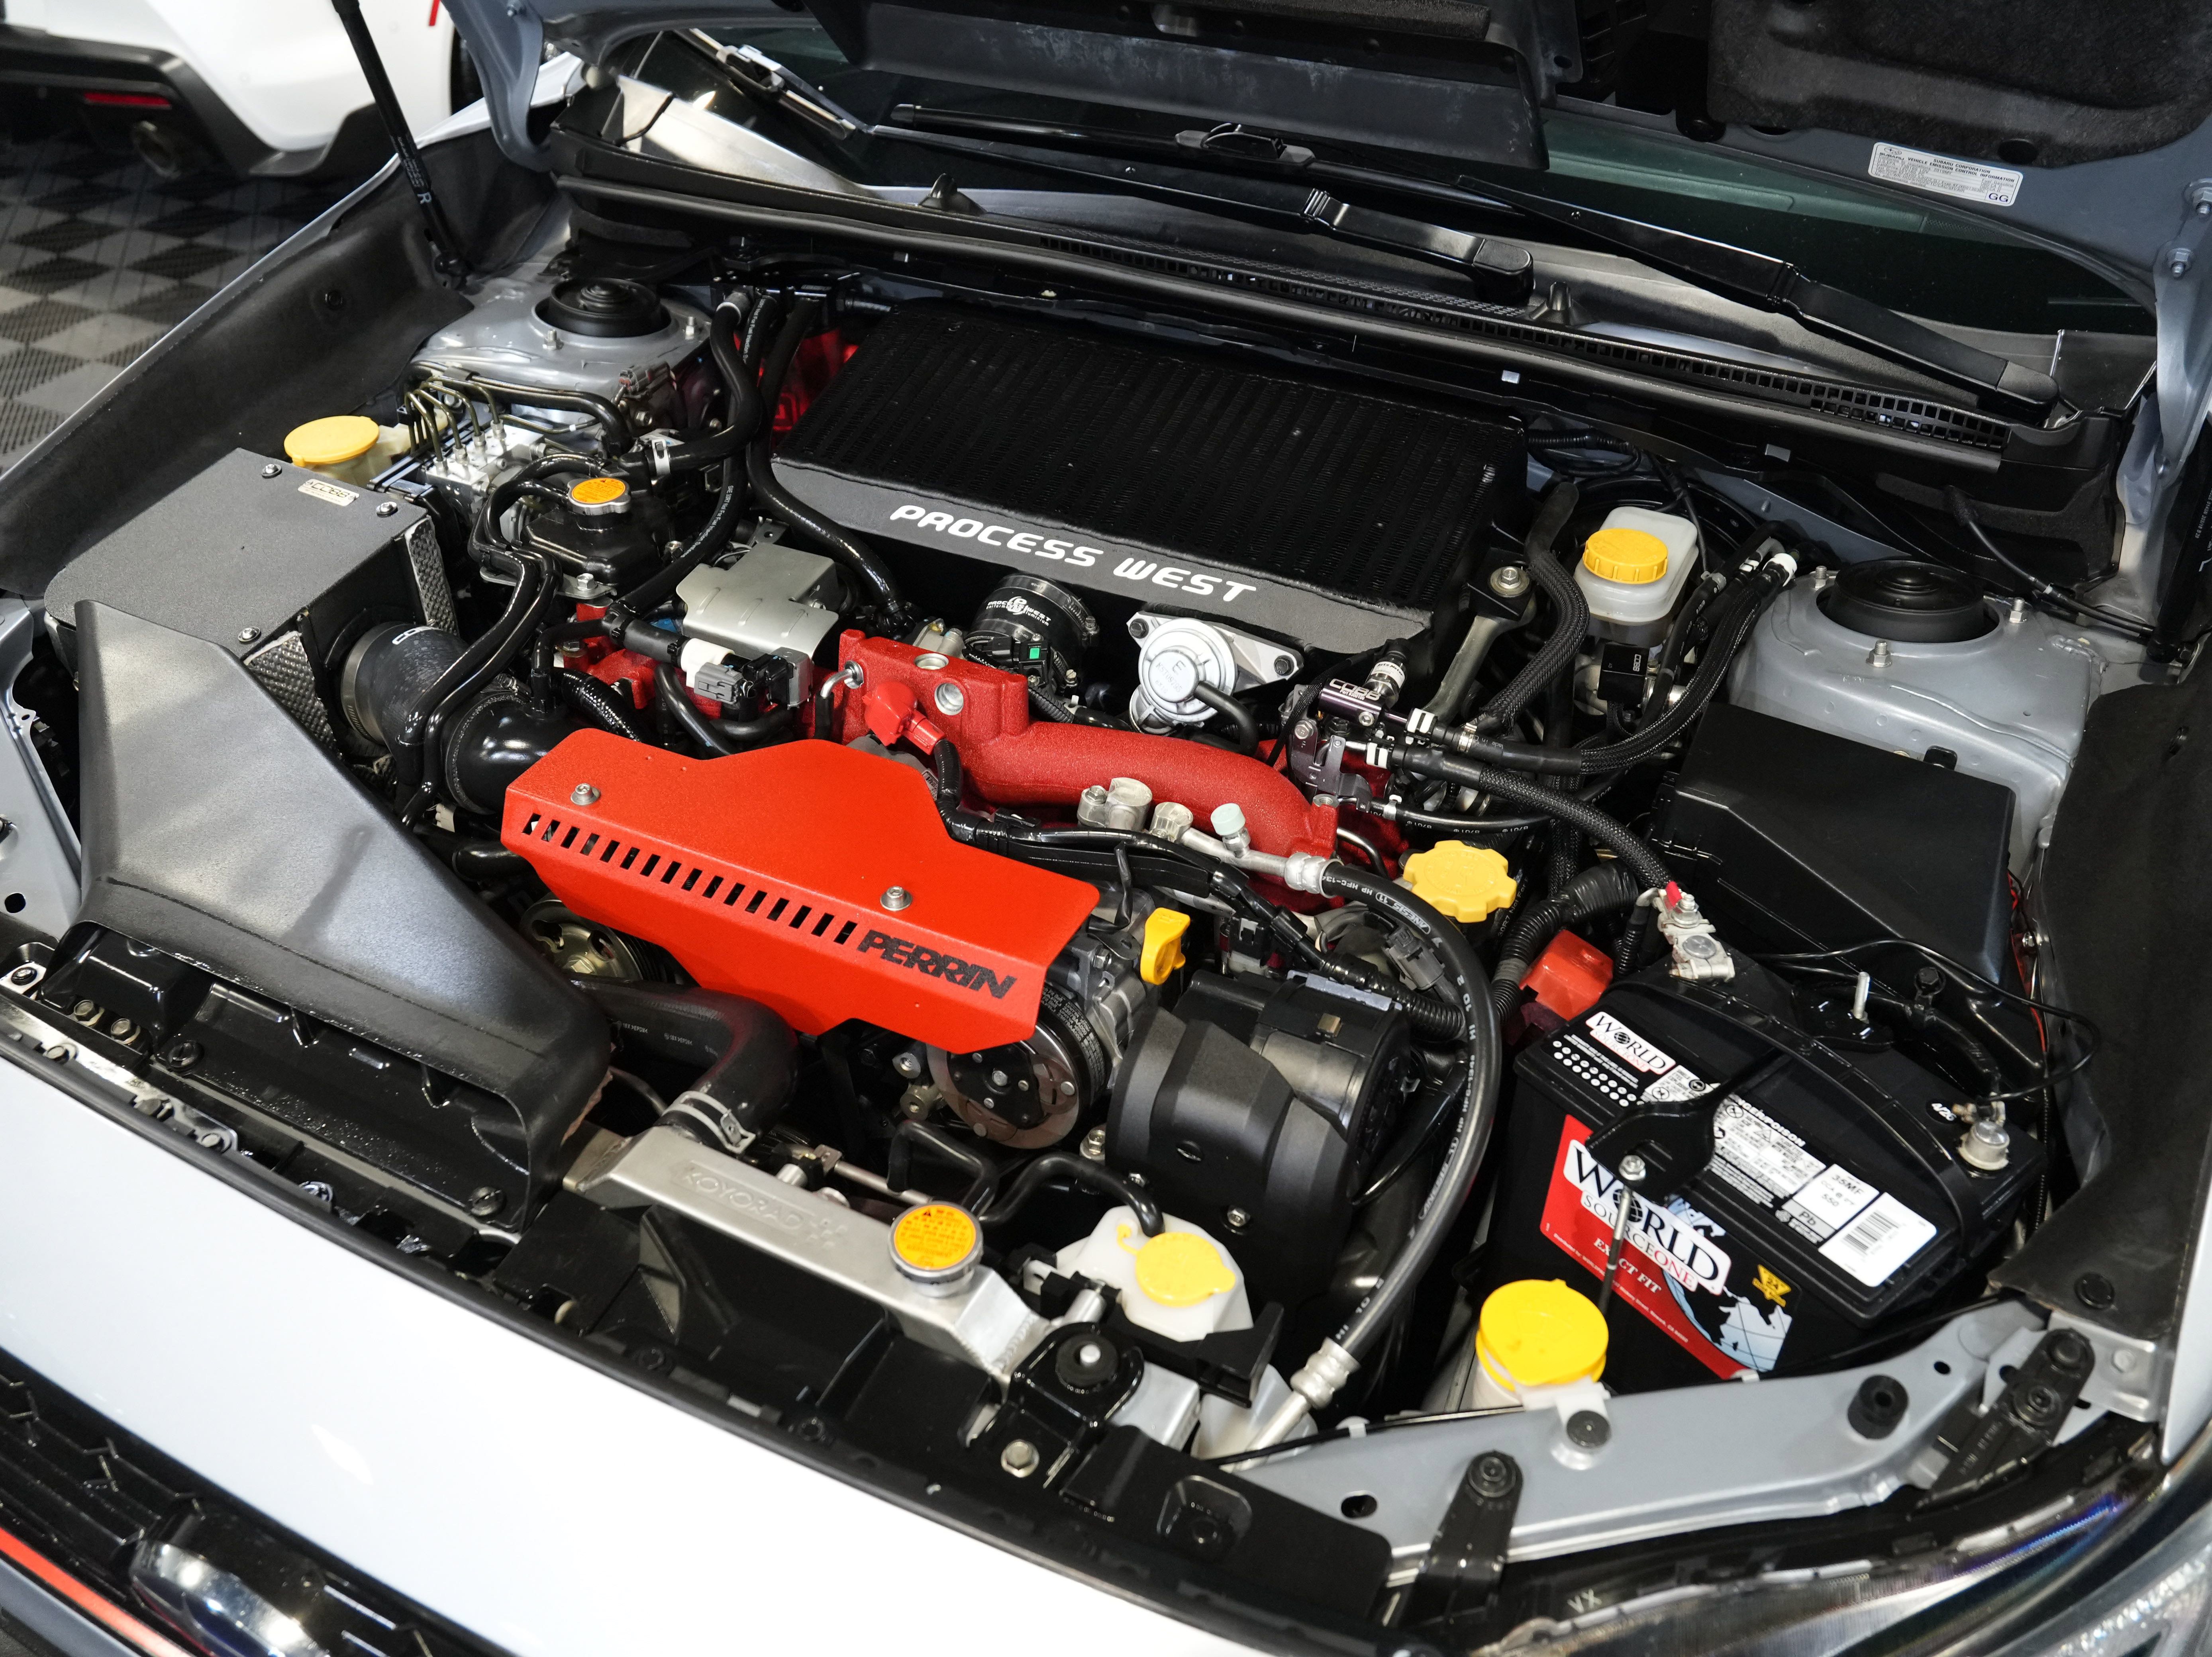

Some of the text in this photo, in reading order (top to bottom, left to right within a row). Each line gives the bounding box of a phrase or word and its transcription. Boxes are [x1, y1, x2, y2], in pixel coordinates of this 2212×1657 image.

[1929, 162, 1953, 171] EMISSION
[1980, 173, 2014, 182] INFORMATION
[1955, 163, 1990, 174] CORPORATION
[417, 192, 431, 204] R
[1988, 192, 2009, 203] GG
[890, 505, 1257, 602] PROCESS WEST
[1027, 607, 1051, 621] WEST
[1171, 660, 1186, 675] E
[1390, 665, 1403, 676] Meter
[1329, 678, 1382, 701] COBB
[1361, 887, 1373, 896] HP
[1379, 892, 1388, 904] 11
[1509, 899, 1519, 913] Not
[1517, 883, 1526, 897] For
[1392, 901, 1428, 928] ANESIS
[857, 930, 1017, 999] PERRIN
[1595, 1014, 1667, 1069] WORLD
[1832, 1174, 1864, 1197] 35MF
[682, 1172, 804, 1230] KOYORAD
[1821, 1192, 1840, 1208] 550
[1577, 1148, 1718, 1279] WORLD
[1798, 1209, 1818, 1227] Pb
[1593, 1237, 1662, 1295] EXCT FIT
